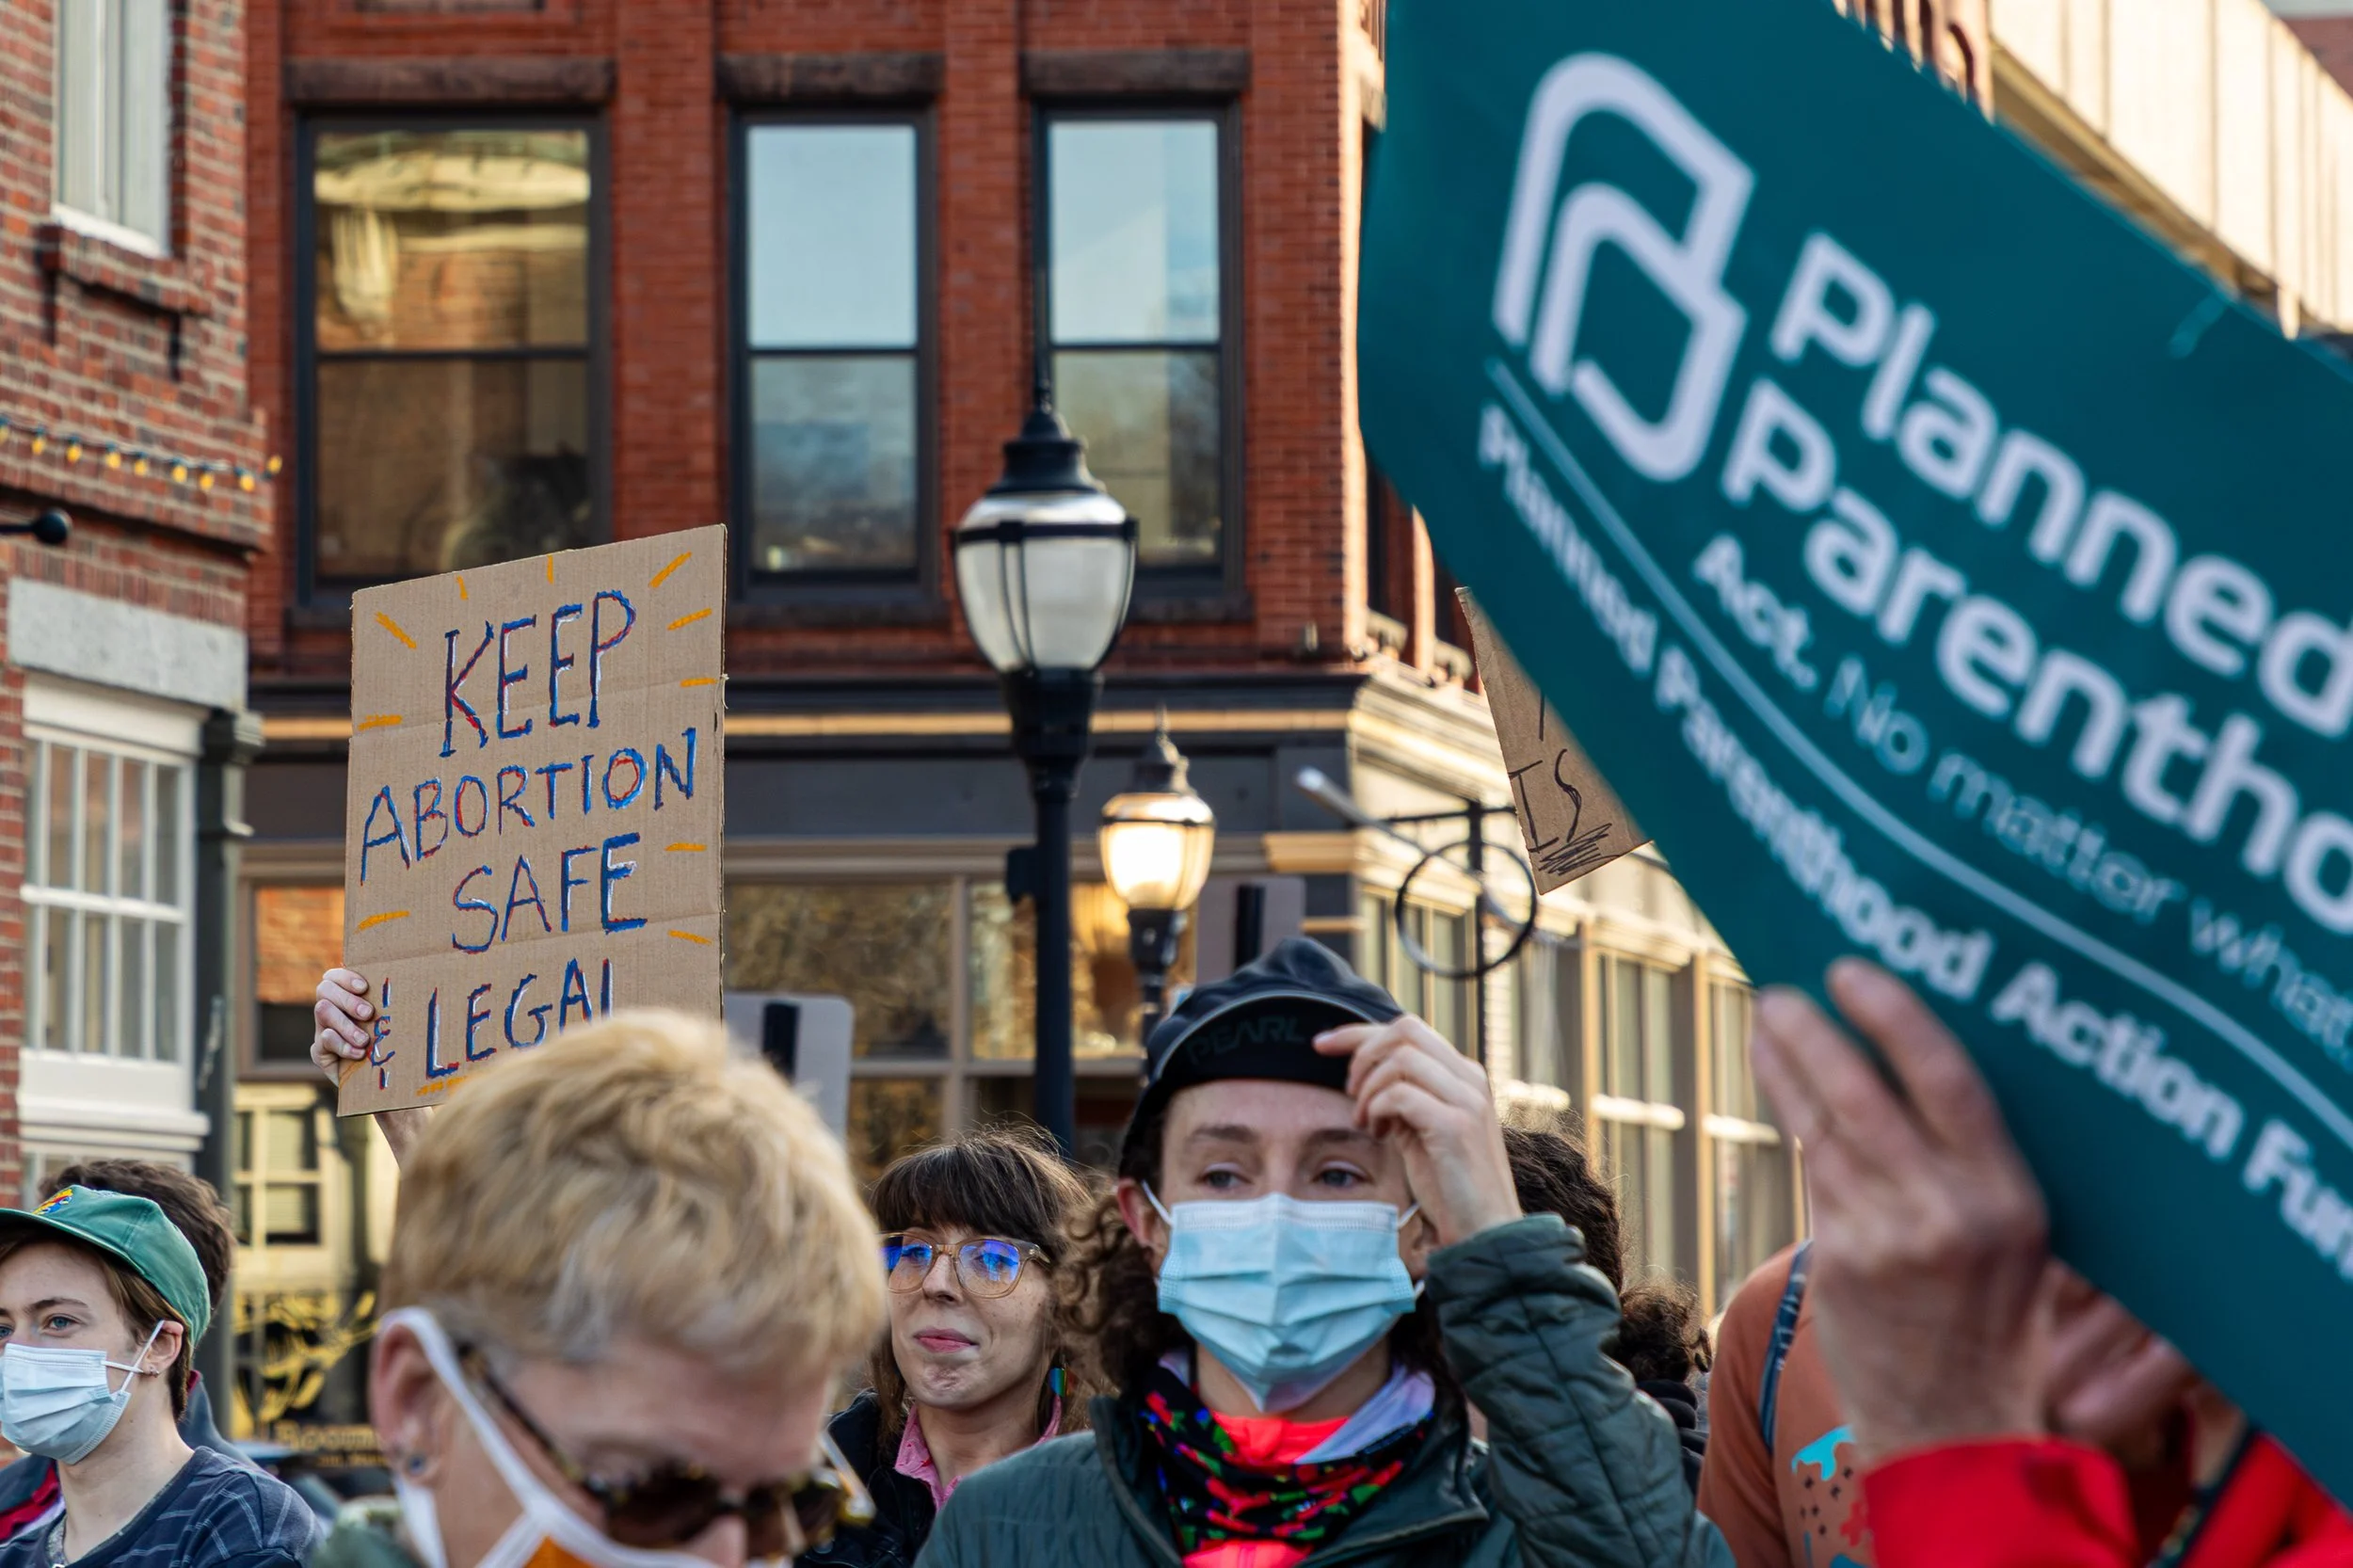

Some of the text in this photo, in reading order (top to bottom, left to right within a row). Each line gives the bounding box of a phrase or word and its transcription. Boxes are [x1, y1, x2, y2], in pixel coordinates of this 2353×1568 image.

[440, 589, 636, 757] KEEP
[1825, 655, 1929, 775] No
[360, 728, 696, 886] ABORTION
[452, 832, 648, 954] SAFE
[1185, 1015, 1306, 1065] PEARL
[1988, 963, 2245, 1161] Action
